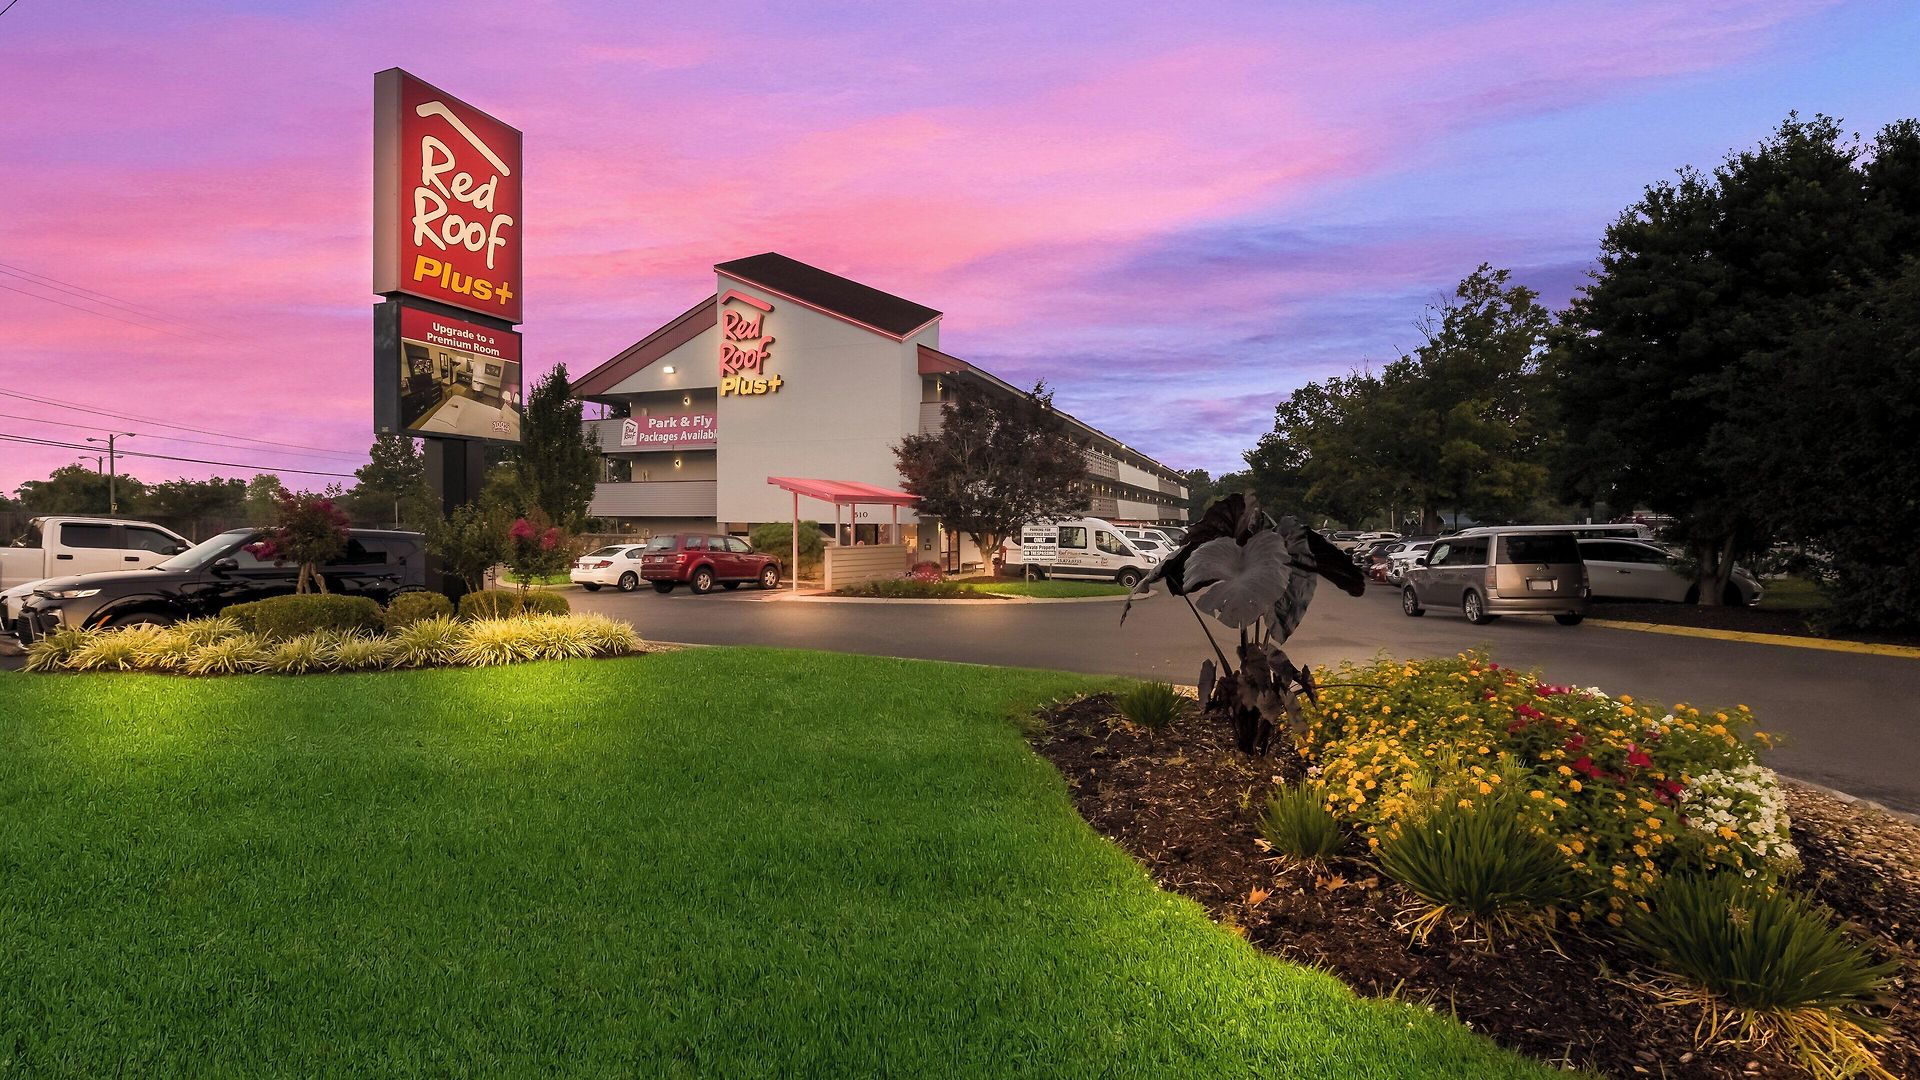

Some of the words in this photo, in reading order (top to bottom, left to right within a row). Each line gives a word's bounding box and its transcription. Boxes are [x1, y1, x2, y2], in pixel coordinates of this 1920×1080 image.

[421, 135, 498, 213] Red
[412, 186, 514, 270] Roof
[413, 254, 513, 305] Plus+
[432, 322, 475, 340] Upgrade
[476, 333, 487, 343] to
[488, 337, 495, 345] a
[722, 309, 763, 341] Red
[426, 332, 472, 350] Premium
[473, 342, 500, 356] Room
[719, 335, 773, 377] Roof
[720, 374, 783, 397] Plus+
[648, 417, 677, 429] Park
[680, 416, 690, 427] &
[693, 415, 713, 428] Fly
[639, 431, 678, 444] Packages
[680, 429, 717, 441] Availabl
